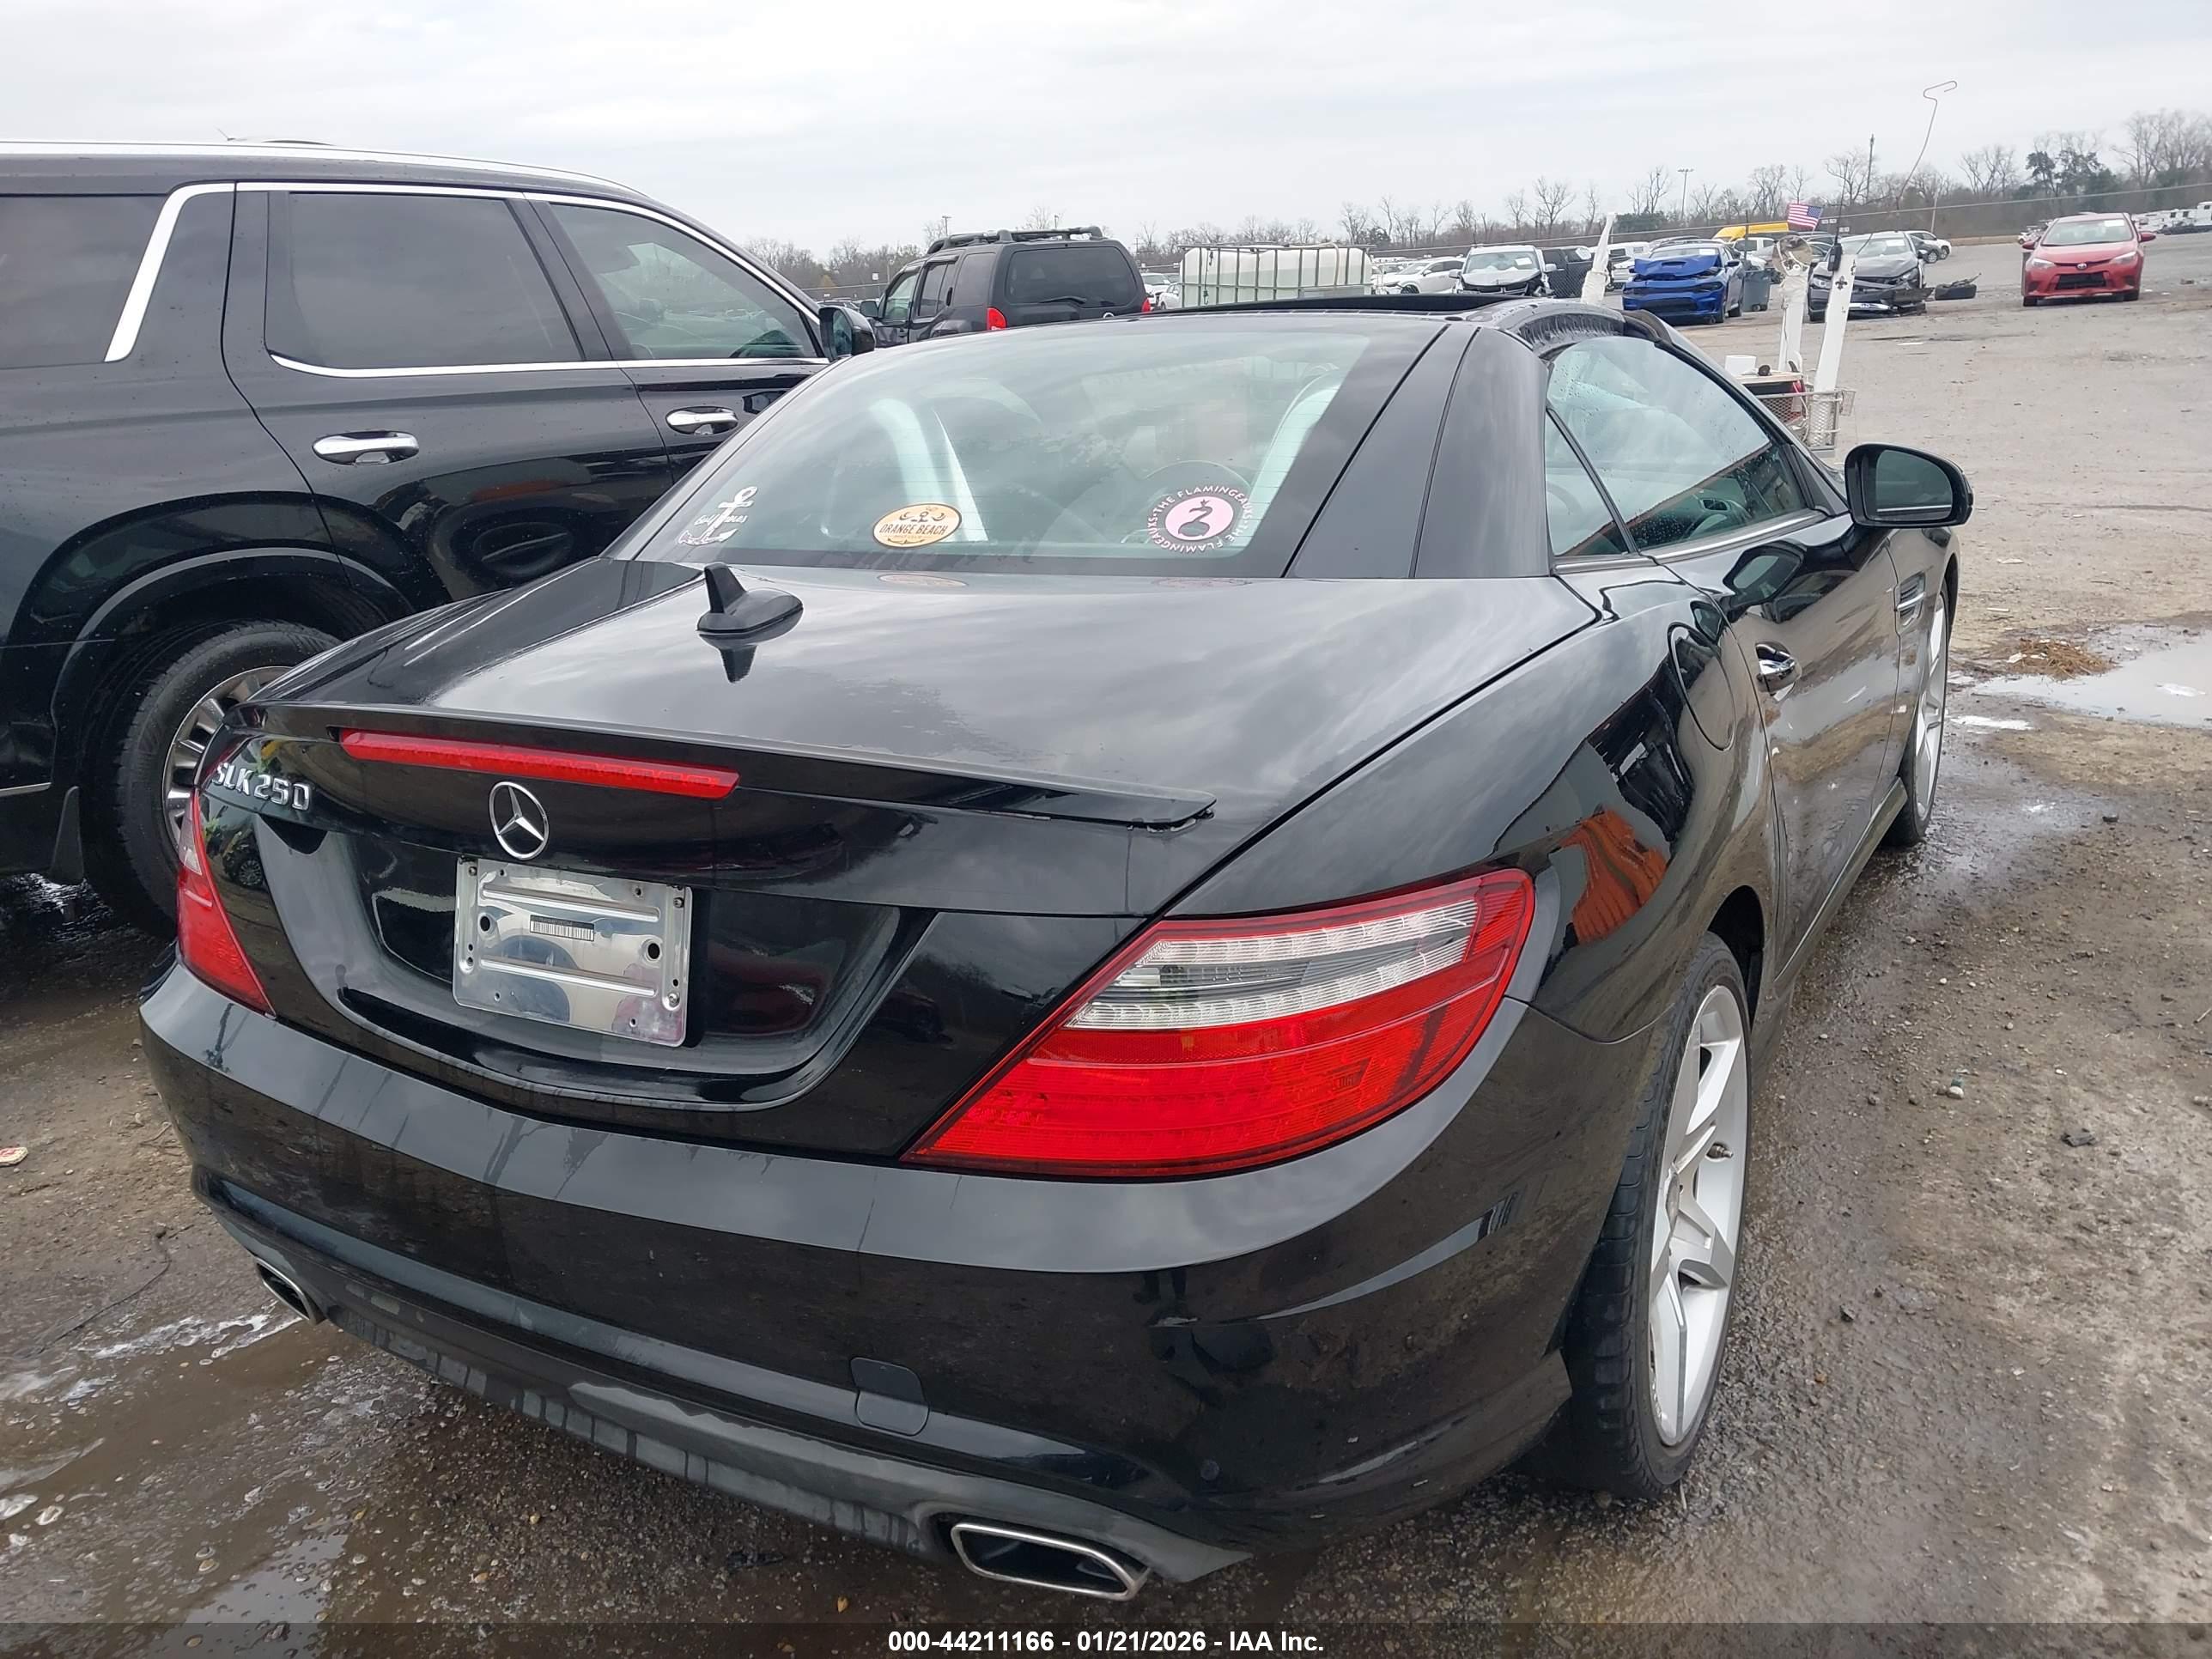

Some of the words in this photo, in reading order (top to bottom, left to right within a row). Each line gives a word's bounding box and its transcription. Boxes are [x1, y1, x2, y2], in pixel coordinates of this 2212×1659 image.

[1153, 496, 1176, 514] THE
[879, 523, 917, 534] ORANGE
[915, 524, 948, 535] BEACH
